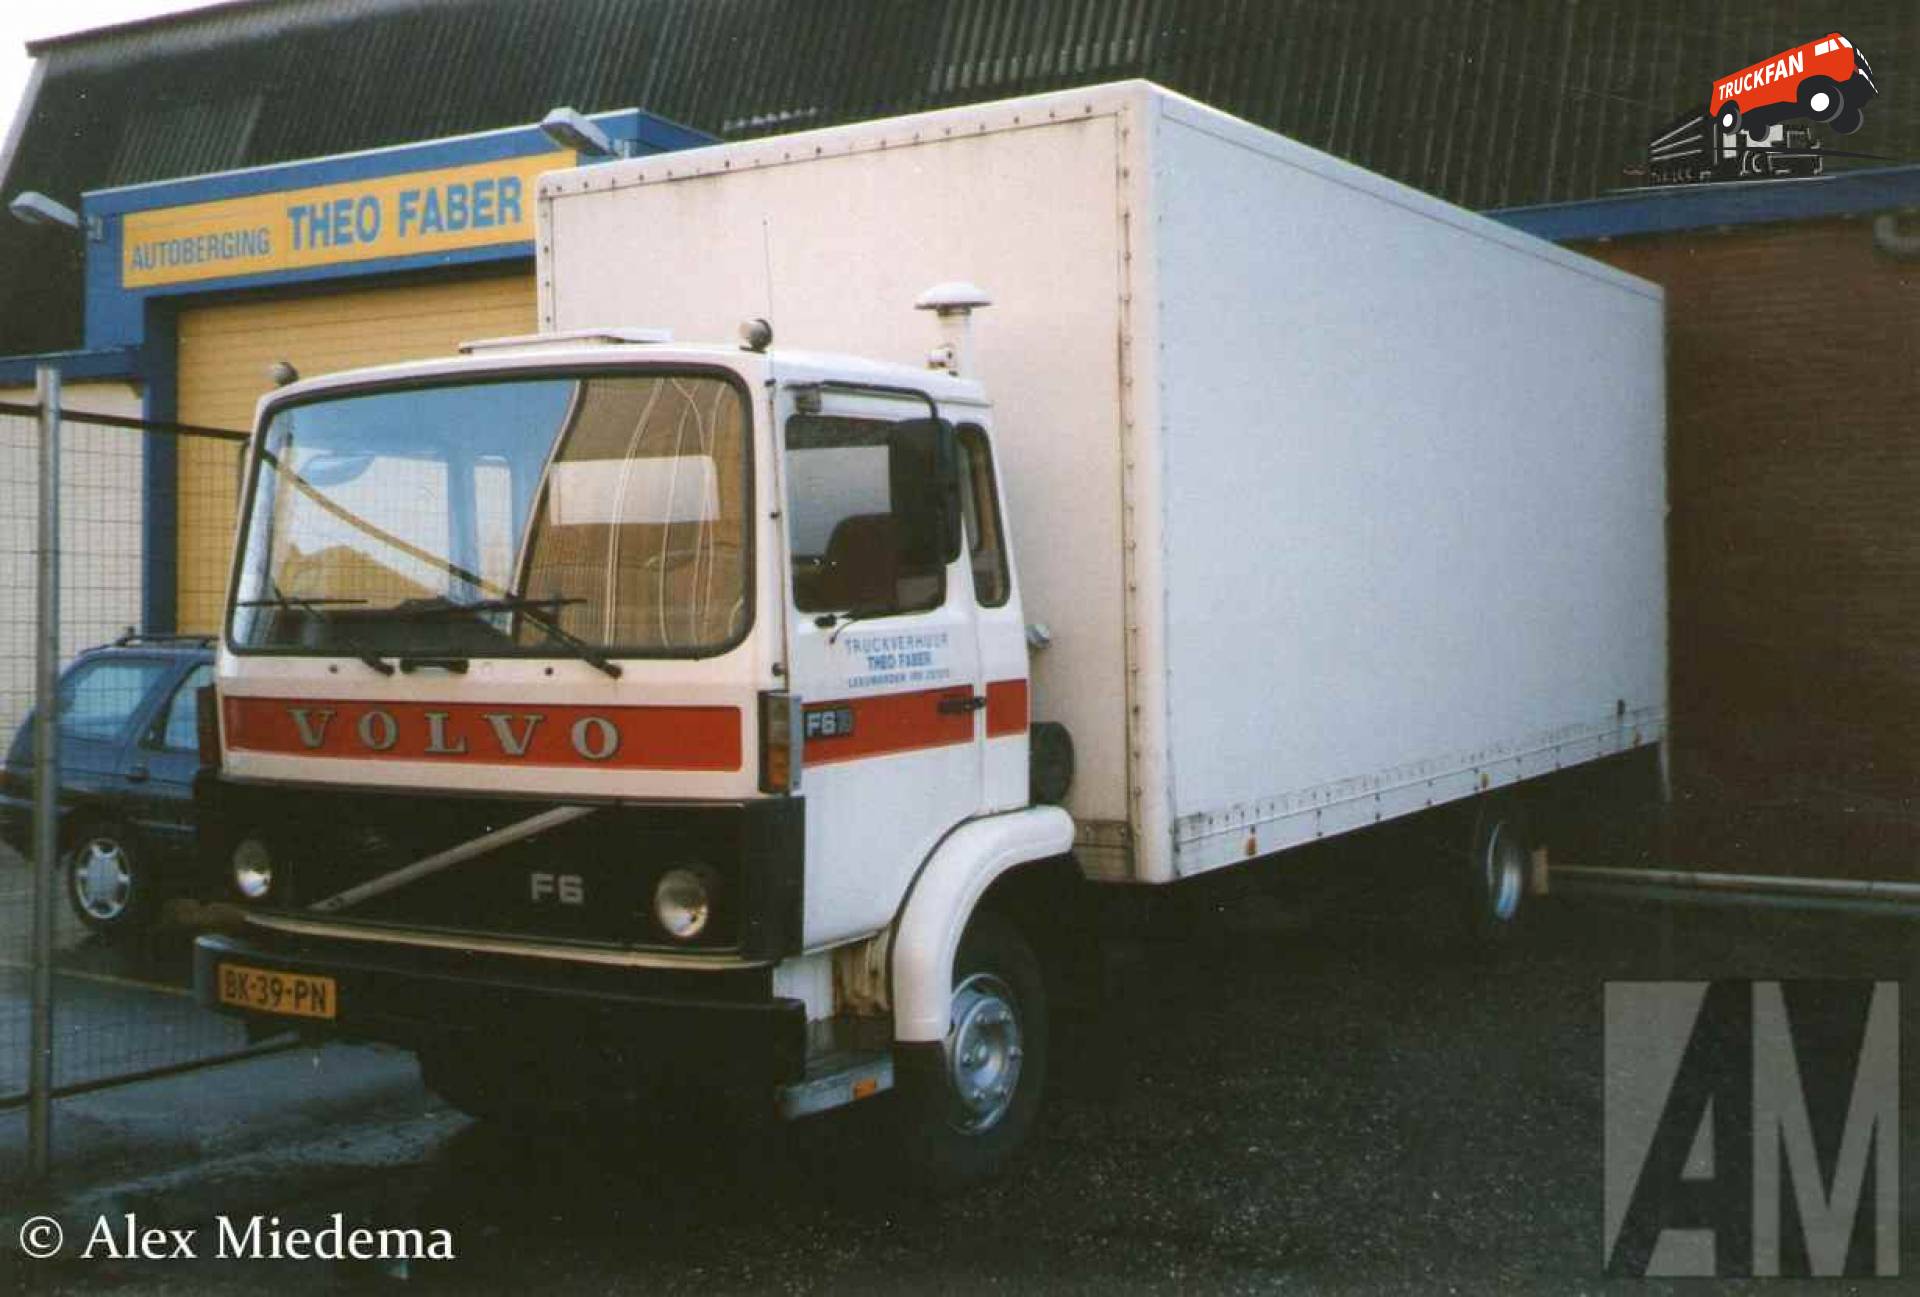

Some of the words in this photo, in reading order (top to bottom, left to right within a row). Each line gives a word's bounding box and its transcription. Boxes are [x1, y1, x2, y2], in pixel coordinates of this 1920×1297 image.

[132, 227, 270, 271] AUTOBERGING
[287, 195, 382, 250] THEO
[398, 176, 522, 239] FABER
[288, 708, 621, 760] VOLVO
[530, 872, 584, 904] F6
